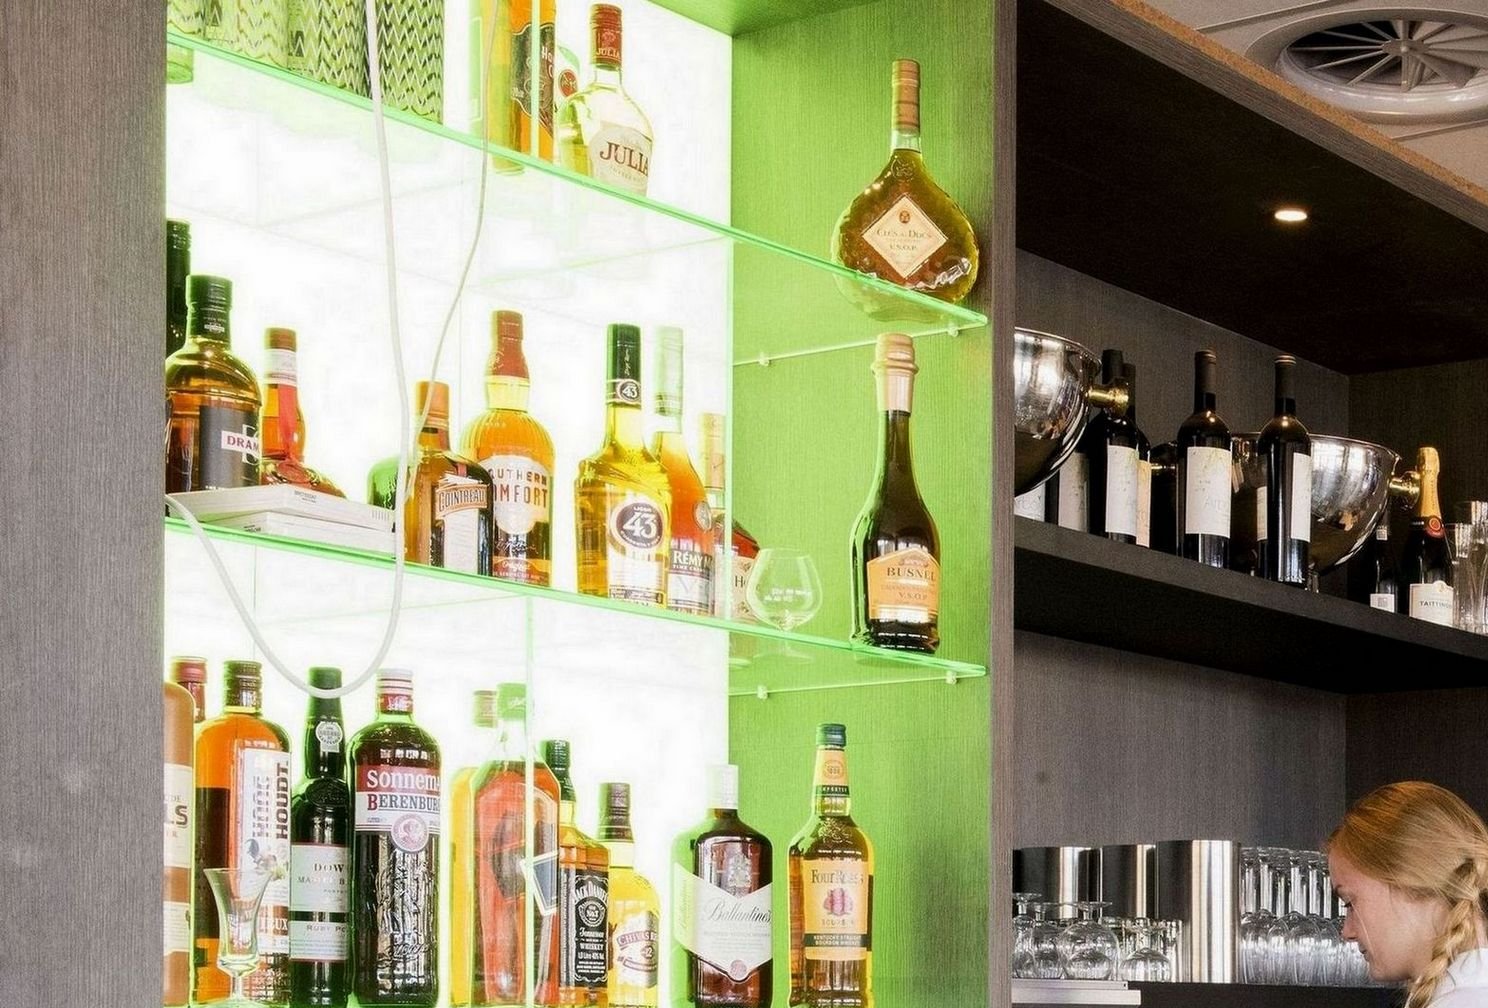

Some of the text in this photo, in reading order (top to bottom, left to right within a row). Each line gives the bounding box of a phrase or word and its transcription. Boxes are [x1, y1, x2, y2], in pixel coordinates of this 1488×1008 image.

[600, 141, 648, 177] JULIA
[488, 468, 547, 486] OUTHERN
[439, 486, 487, 513] COINTREAU
[493, 484, 548, 508] OMFORT
[622, 511, 658, 540] 43
[672, 549, 703, 566] RÉMY
[367, 793, 440, 811] BERENBUR
